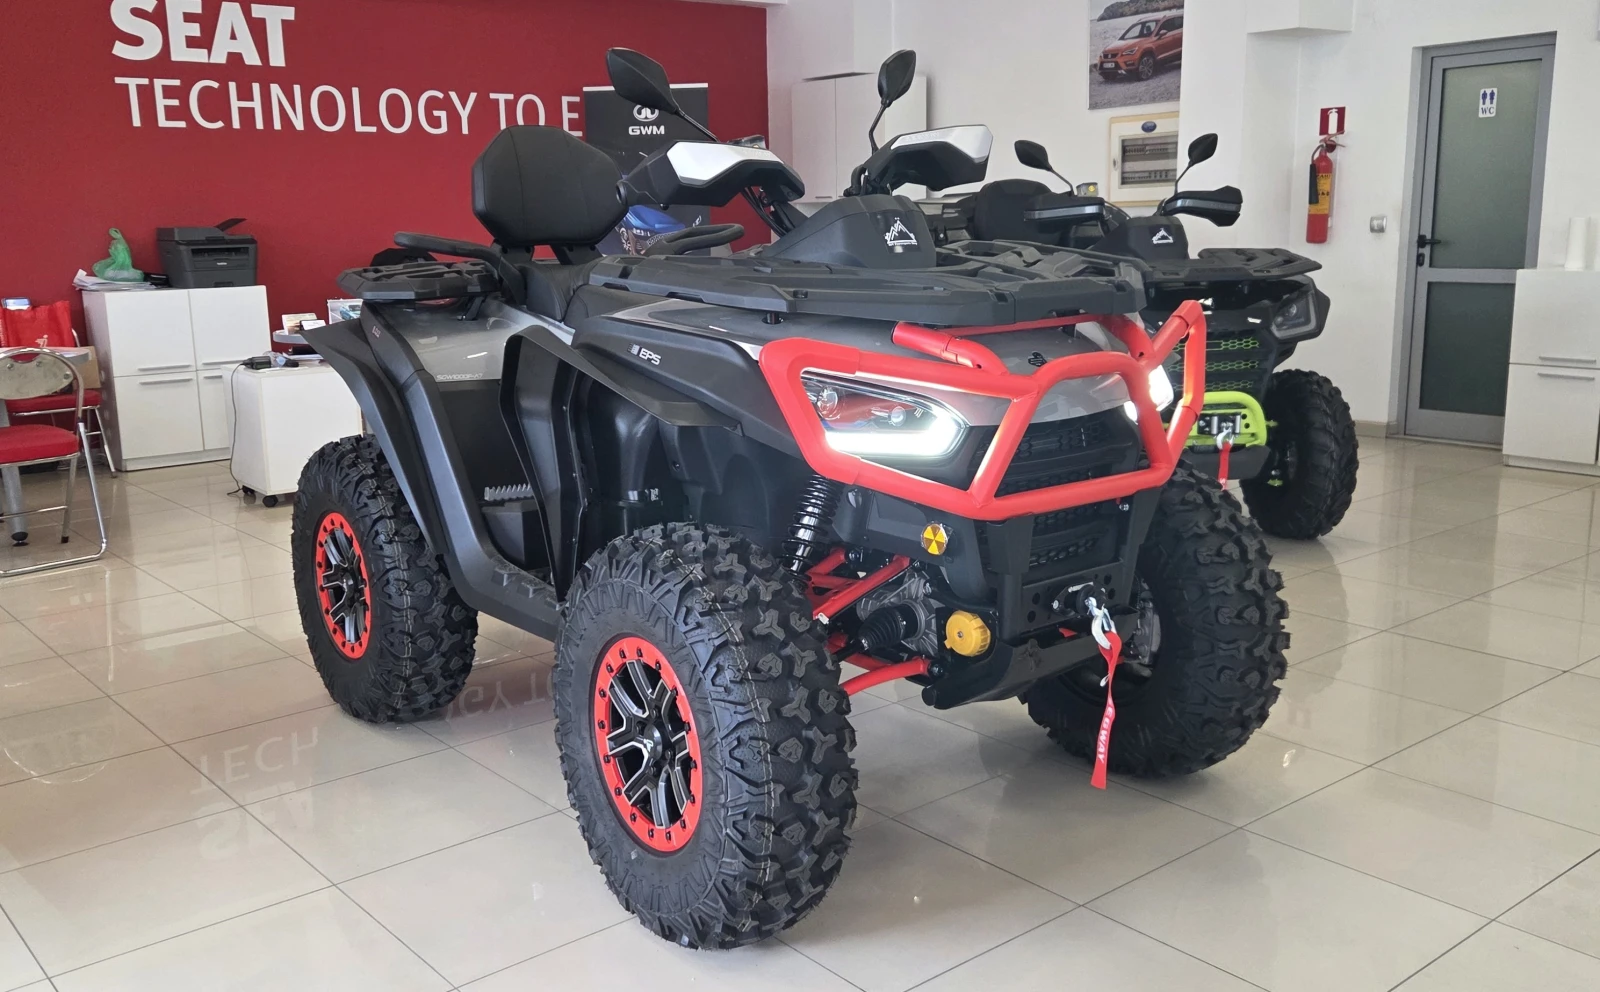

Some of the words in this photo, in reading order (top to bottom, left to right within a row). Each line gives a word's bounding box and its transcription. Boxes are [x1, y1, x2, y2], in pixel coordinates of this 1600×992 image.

[110, 0, 295, 67] SEAT
[114, 76, 477, 135] TECHNOLOGY
[489, 93, 546, 131] TO
[1481, 106, 1495, 115] WC
[628, 125, 665, 136] GWM
[639, 347, 662, 366] EPS
[1097, 697, 1114, 764] EGWAY
